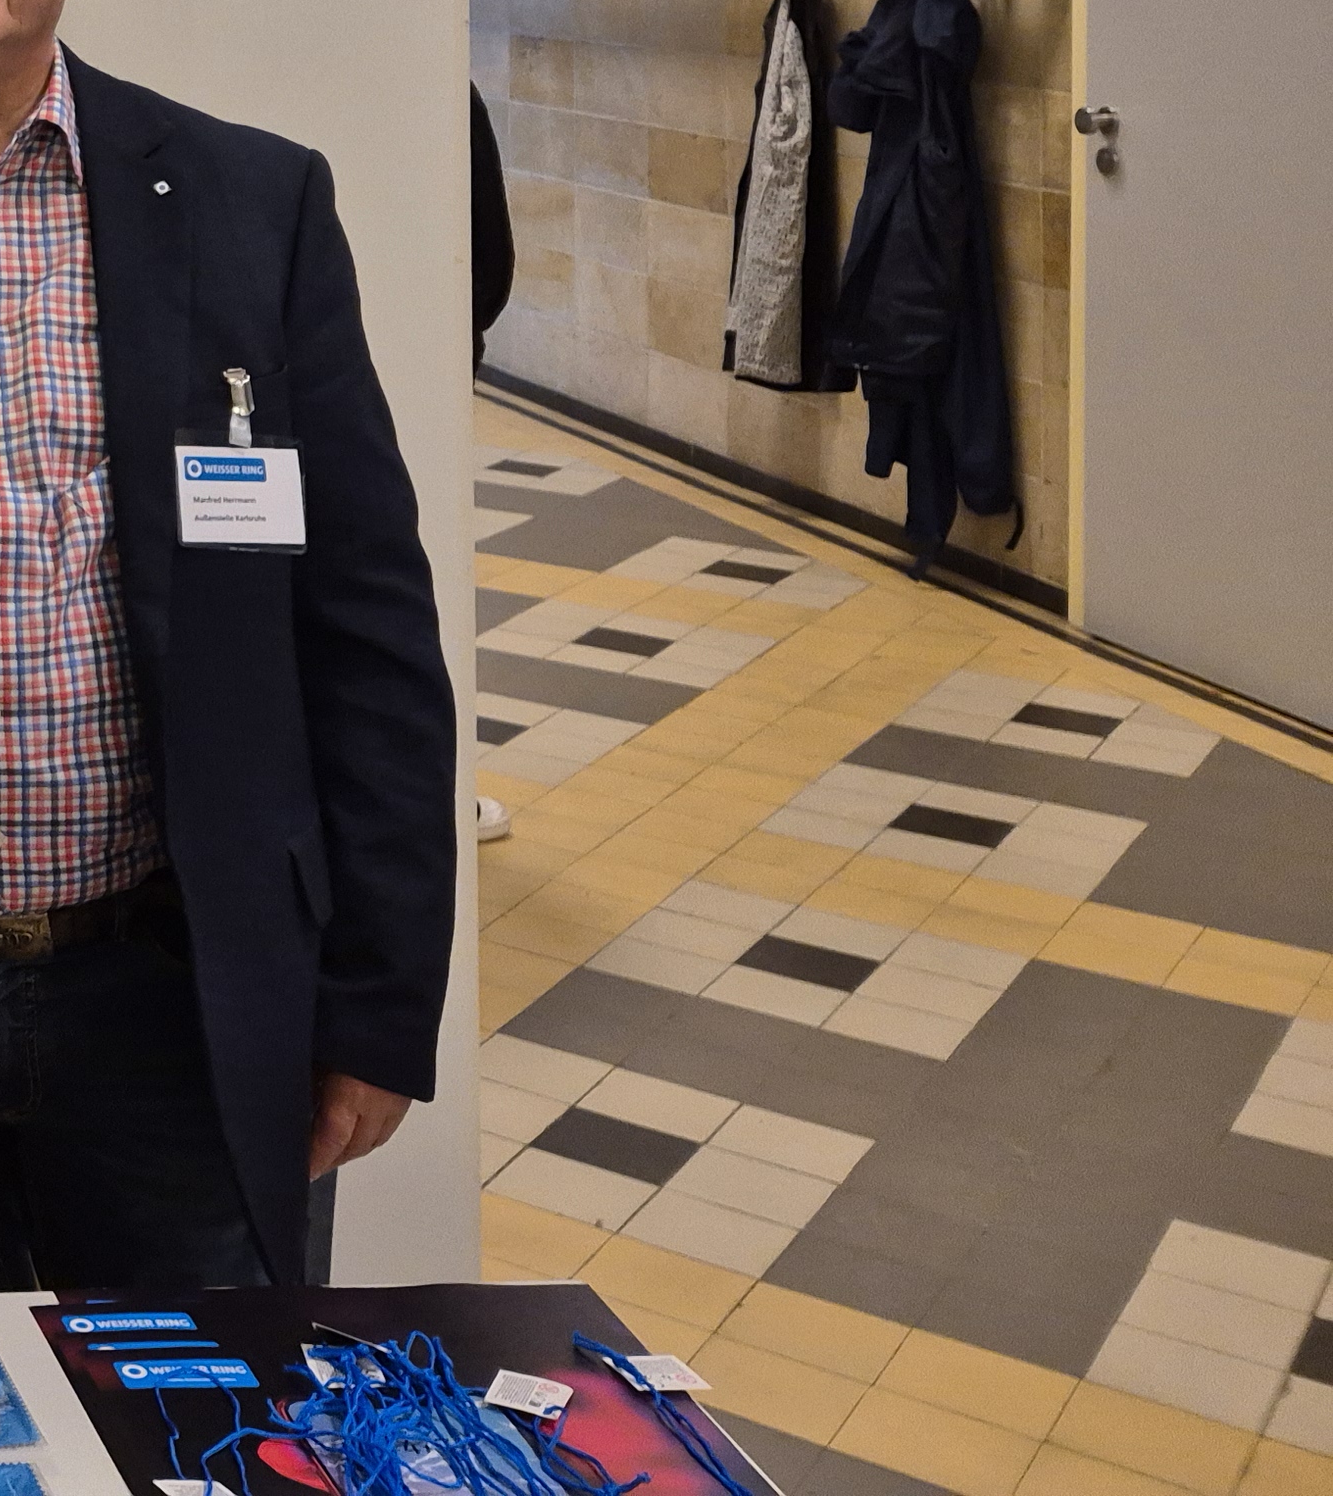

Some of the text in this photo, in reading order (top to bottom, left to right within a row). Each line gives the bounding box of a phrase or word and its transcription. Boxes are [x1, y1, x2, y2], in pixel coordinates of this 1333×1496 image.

[203, 464, 264, 475] WEISSER RING
[193, 496, 222, 504] Manfred
[235, 514, 267, 522] Karlsruhe
[95, 1318, 191, 1330] WEISSER RING
[209, 1365, 247, 1375] RING
